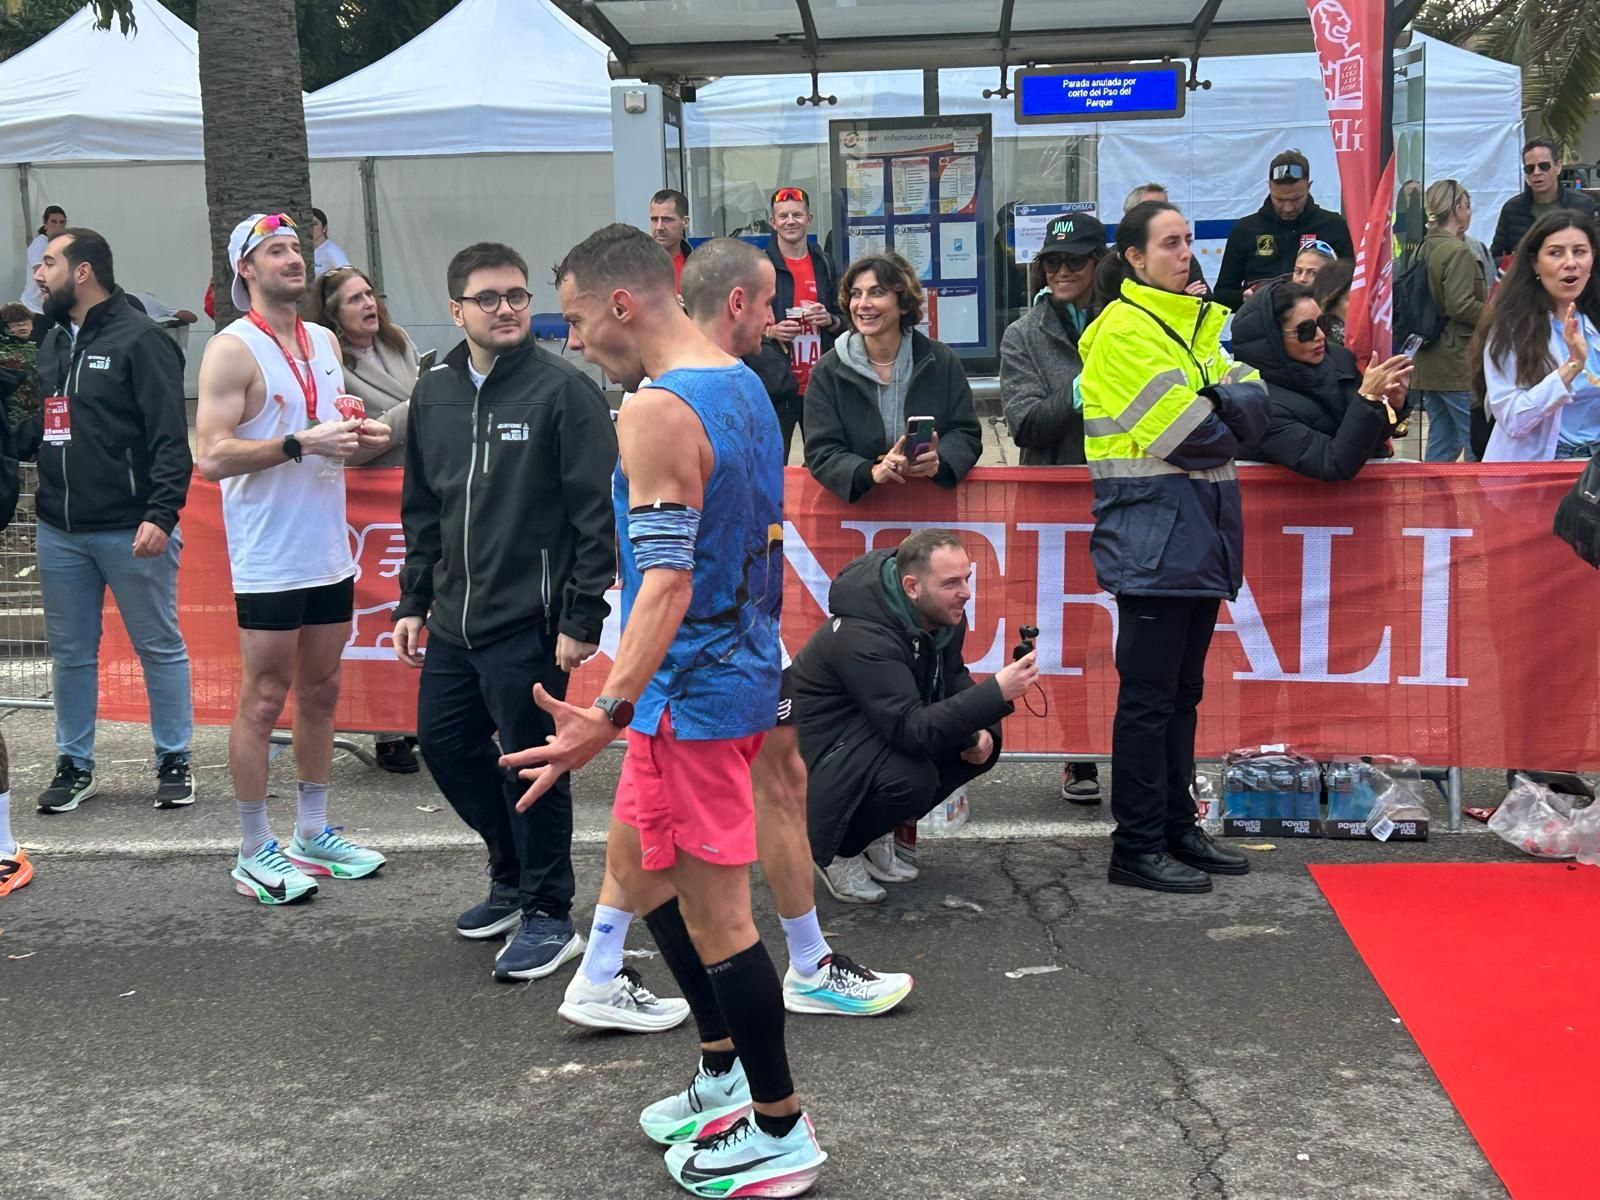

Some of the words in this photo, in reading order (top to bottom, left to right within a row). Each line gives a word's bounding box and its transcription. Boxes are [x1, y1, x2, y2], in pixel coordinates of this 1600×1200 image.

[1062, 79, 1090, 88] Parada
[1091, 77, 1122, 87] anulada
[1123, 78, 1137, 88] por
[1067, 89, 1088, 98] corte
[1089, 88, 1101, 97] del
[1103, 87, 1118, 96] Pso
[1119, 86, 1132, 96] del
[1085, 98, 1114, 108] Parque
[884, 132, 928, 142] Información
[1052, 220, 1074, 235] JAVA
